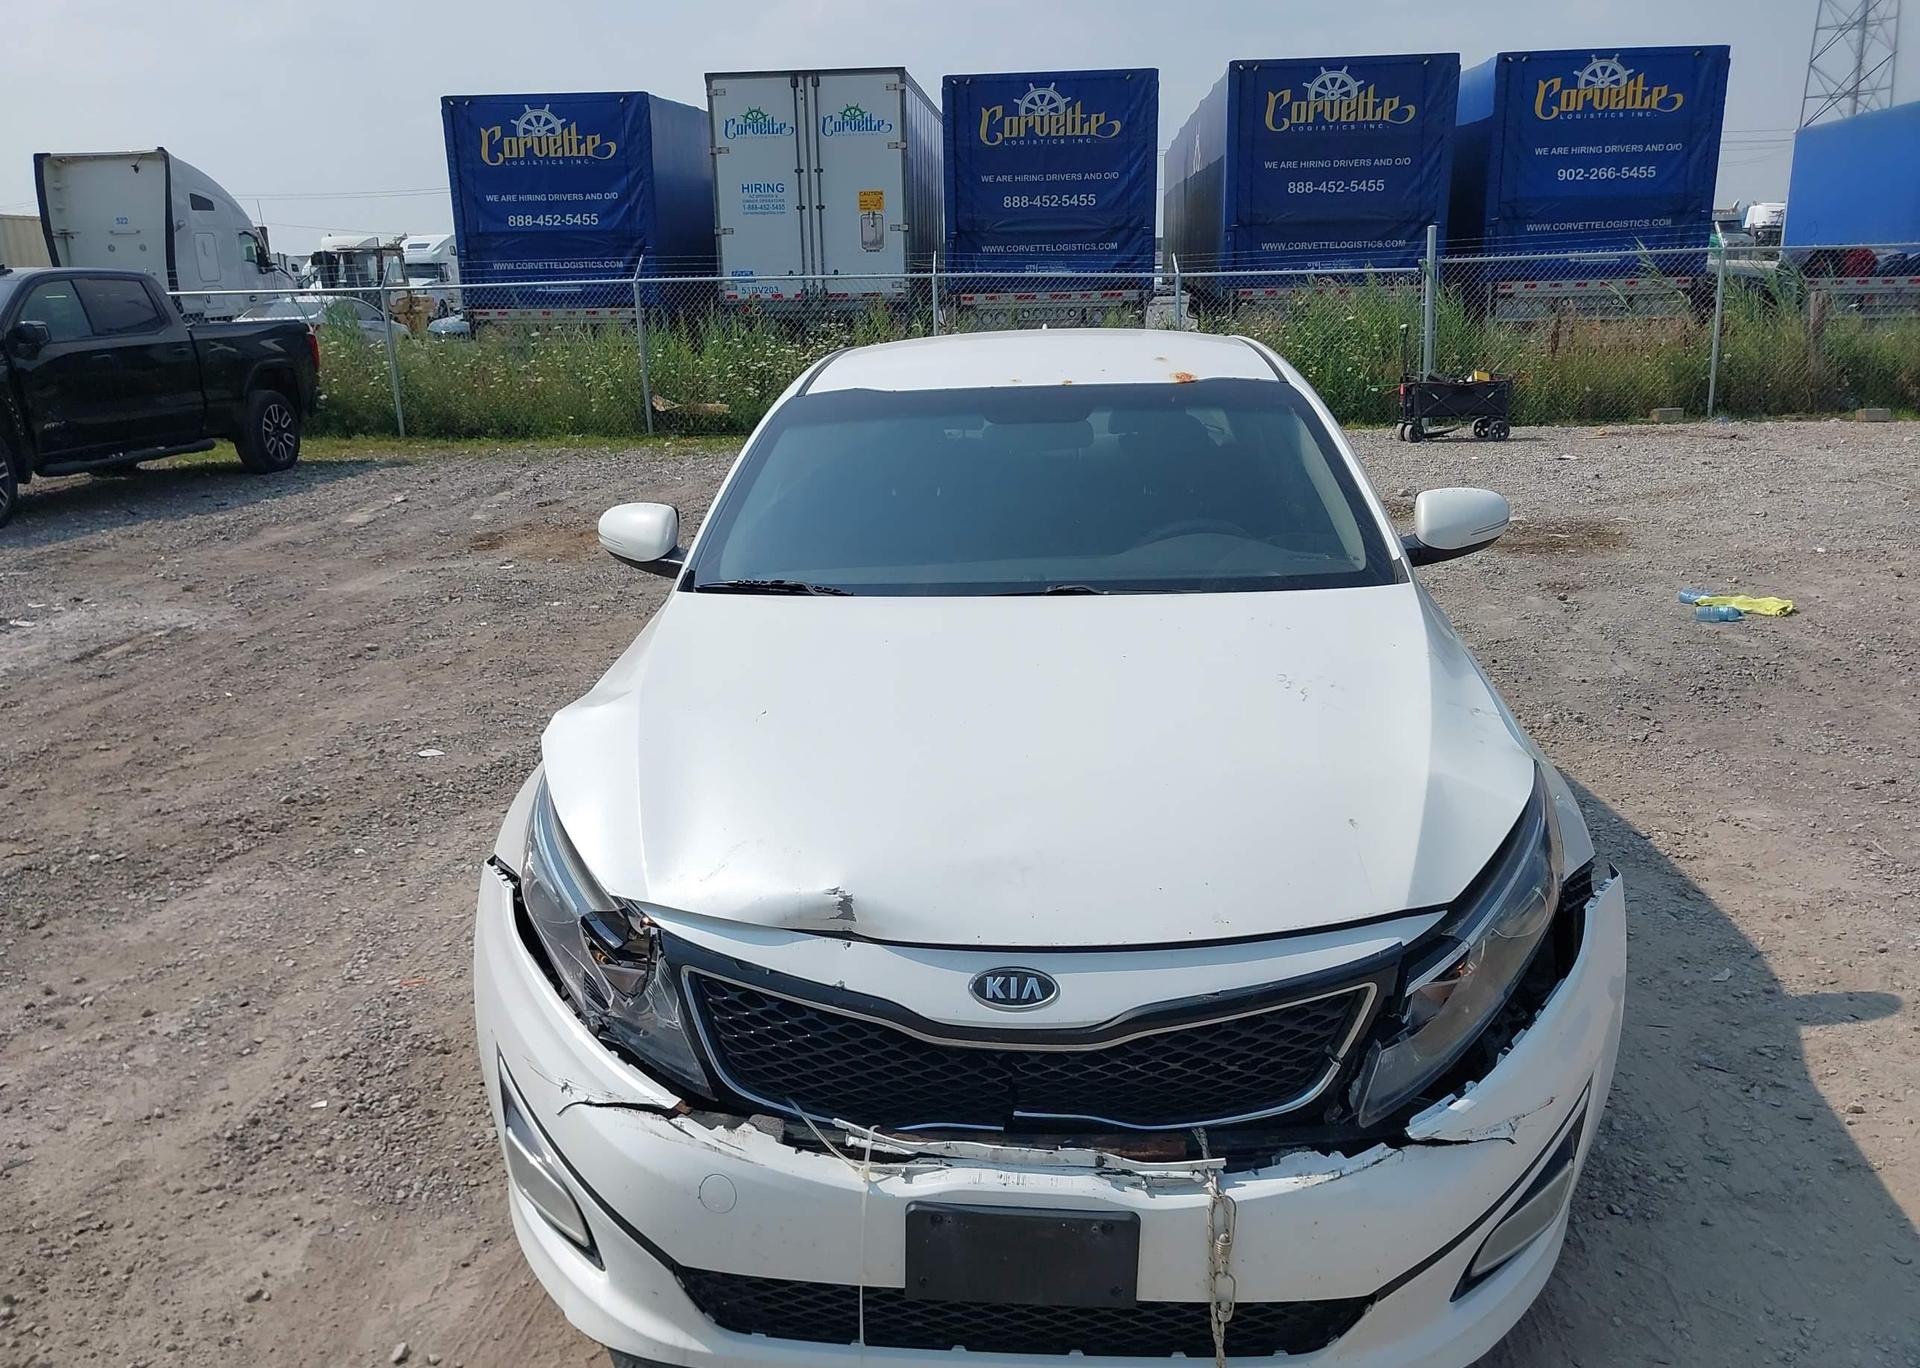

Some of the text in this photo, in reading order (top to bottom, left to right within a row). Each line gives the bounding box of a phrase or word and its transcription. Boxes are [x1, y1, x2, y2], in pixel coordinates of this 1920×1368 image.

[1535, 72, 1683, 120] Corvette
[1265, 84, 1416, 132] Corvette
[1560, 112, 1624, 120] LOGISTICS
[724, 117, 794, 139] Corvette
[822, 113, 892, 137] Corvette
[979, 101, 1121, 146] Corvette
[1291, 124, 1355, 132] LOGISTICS
[480, 121, 617, 166] Corvette
[1004, 138, 1065, 146] LOGISTICS
[1535, 142, 1683, 156] WE ARE HIRING DRIVERS AND O/O
[1264, 157, 1411, 169] WE ARE HIRING DRIVERS AND O/O
[981, 171, 1119, 183] WE ARE HIRING DRIVERS AND O/O
[1557, 166, 1656, 181] 902-266-5455
[741, 183, 785, 193] HIRING
[1287, 179, 1385, 194] 888-452-5455
[486, 192, 618, 202] WE ARE HIRING DRIVERS AND O/O
[1003, 193, 1096, 208] 888-452-5455
[508, 213, 599, 227] 888-452-5455
[981, 241, 1118, 253] WWW.CORVETTELOGISTICS.COM
[1261, 239, 1406, 251] WWW.CORVETTELOGISTICS.COM
[493, 260, 624, 270] WWW.CORVETTELOGISTICS.COM
[985, 976, 1044, 1000] KIA
